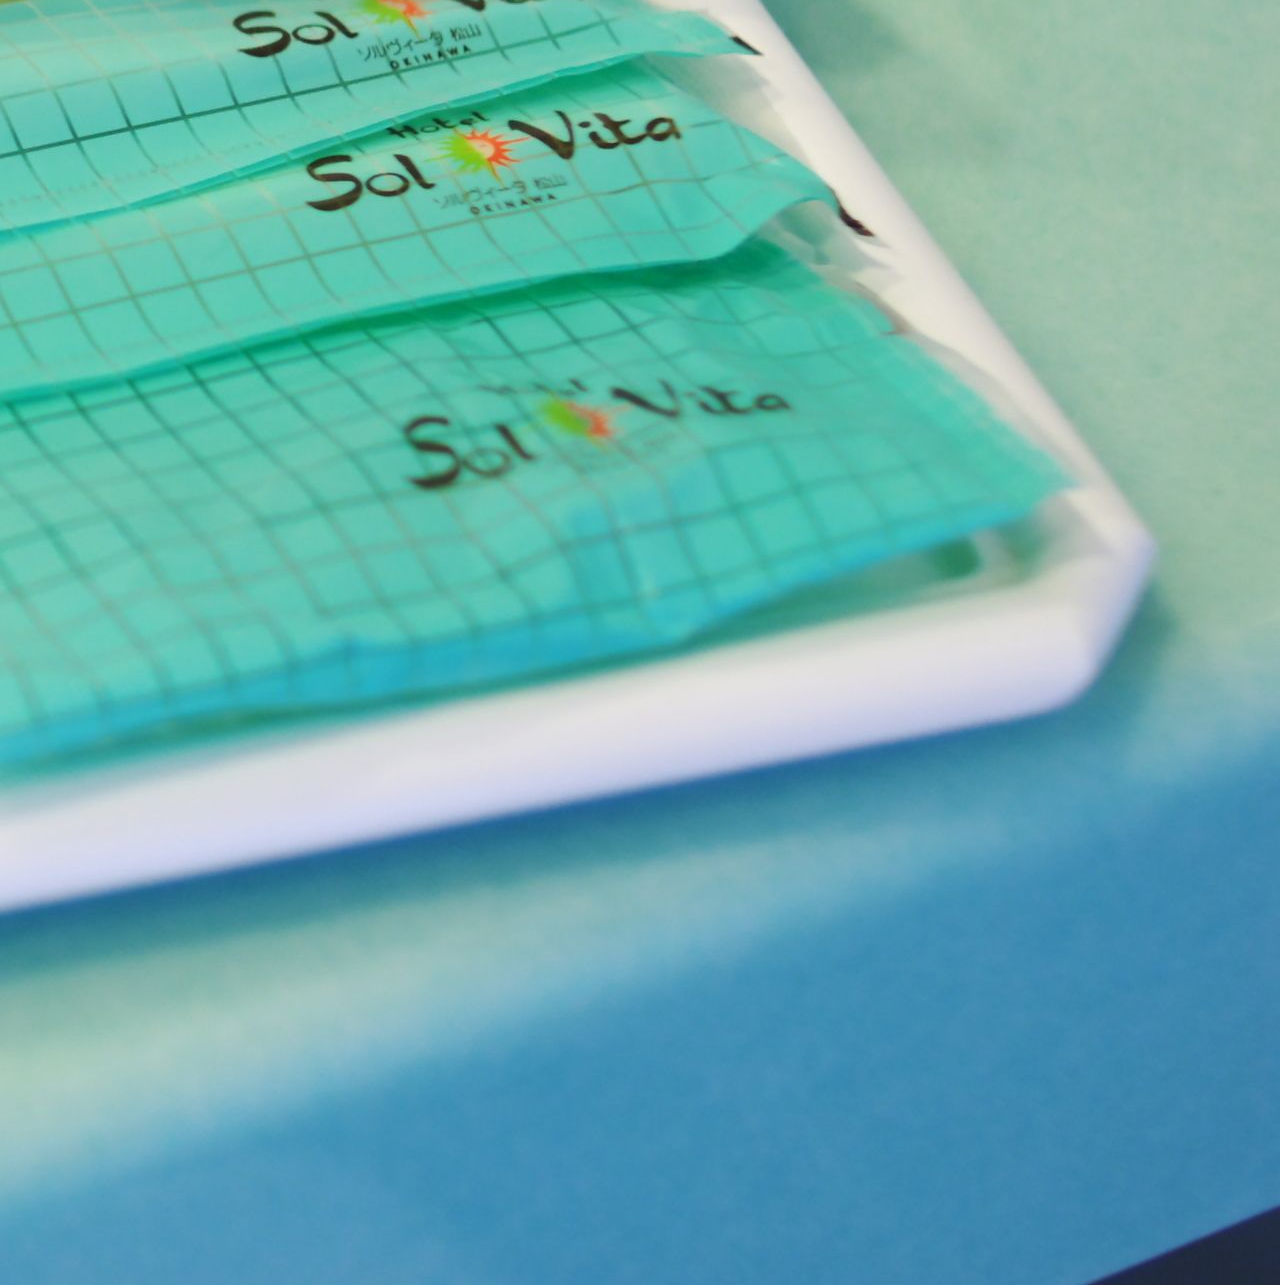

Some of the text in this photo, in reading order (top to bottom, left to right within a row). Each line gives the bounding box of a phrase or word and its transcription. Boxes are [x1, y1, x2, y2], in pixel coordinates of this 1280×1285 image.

[232, 10, 360, 58] Sol
[389, 45, 473, 71] OKINAWA
[386, 111, 490, 139] Hotel
[306, 109, 683, 212] Sol Vita
[468, 192, 558, 217] OKINAWA
[402, 414, 538, 489] Sol
[610, 377, 793, 419] Vita
